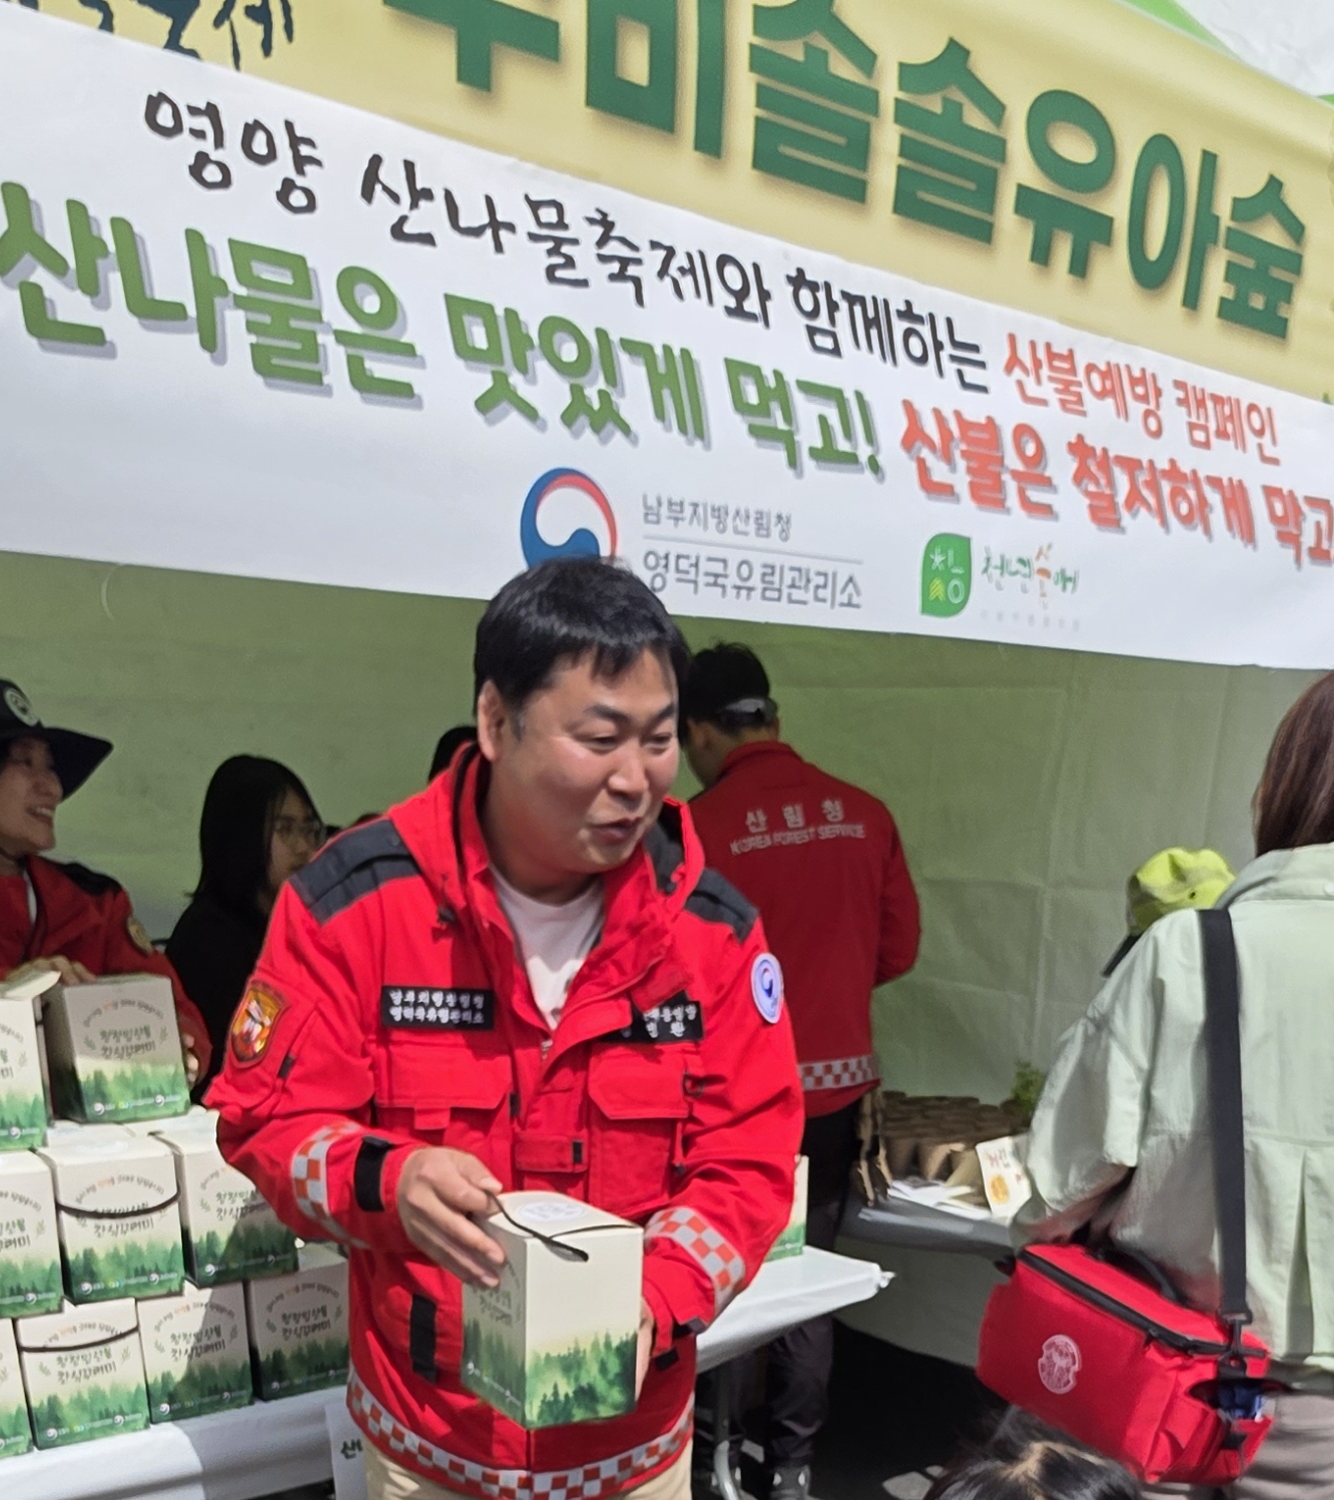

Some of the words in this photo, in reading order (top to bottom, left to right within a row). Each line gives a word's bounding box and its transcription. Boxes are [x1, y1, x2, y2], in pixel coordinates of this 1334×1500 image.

[143, 89, 324, 215] 영양
[359, 153, 772, 329] 산나물축제와
[785, 266, 990, 394] 함께하는
[1003, 333, 1164, 440] 산불예방
[1172, 378, 1282, 466] 캠페인
[443, 293, 709, 445] 맛있게
[723, 357, 882, 476] 먹고!
[900, 398, 1057, 518] 산불은
[1066, 433, 1256, 547] 철저하게
[641, 492, 794, 543] 남부지방산림청
[642, 549, 864, 610] 영덕국유림관리소
